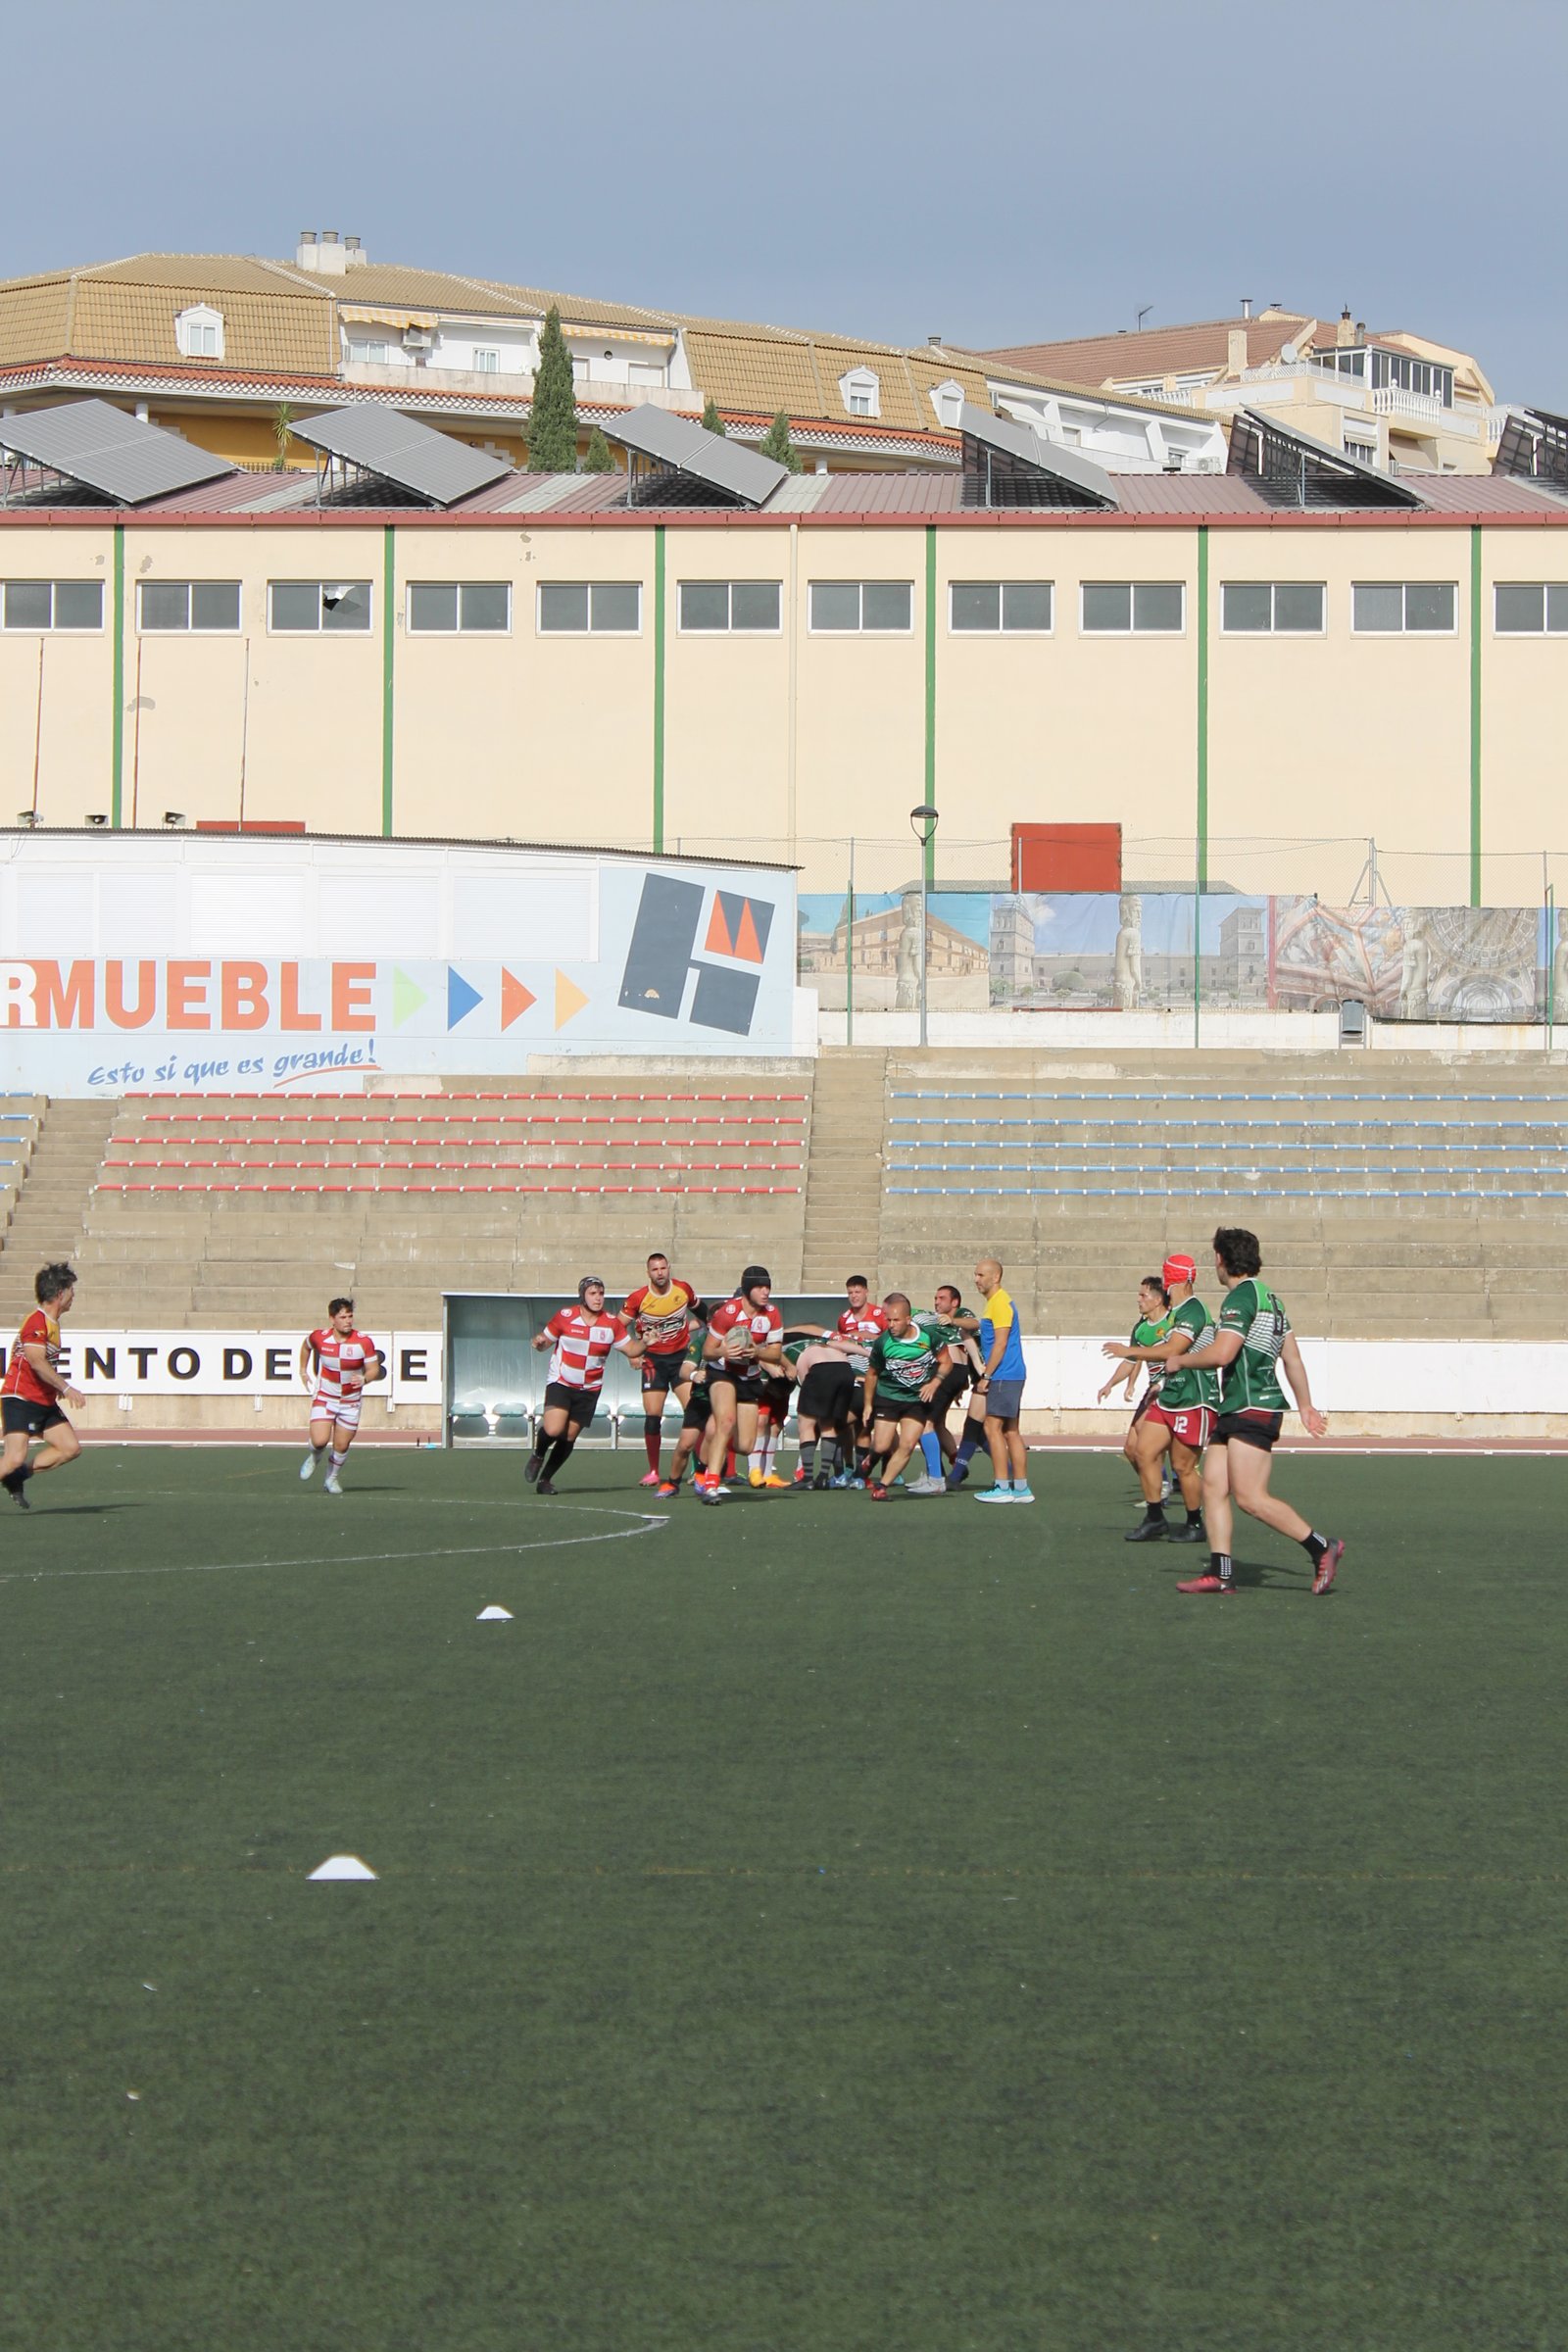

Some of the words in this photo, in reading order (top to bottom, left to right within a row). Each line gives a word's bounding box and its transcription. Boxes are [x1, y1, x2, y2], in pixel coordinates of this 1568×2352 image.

[86, 1060, 145, 1085] Esto
[183, 1059, 229, 1086] que
[237, 1056, 265, 1075] es
[223, 1348, 292, 1380] DE
[1173, 1415, 1188, 1434] 12
